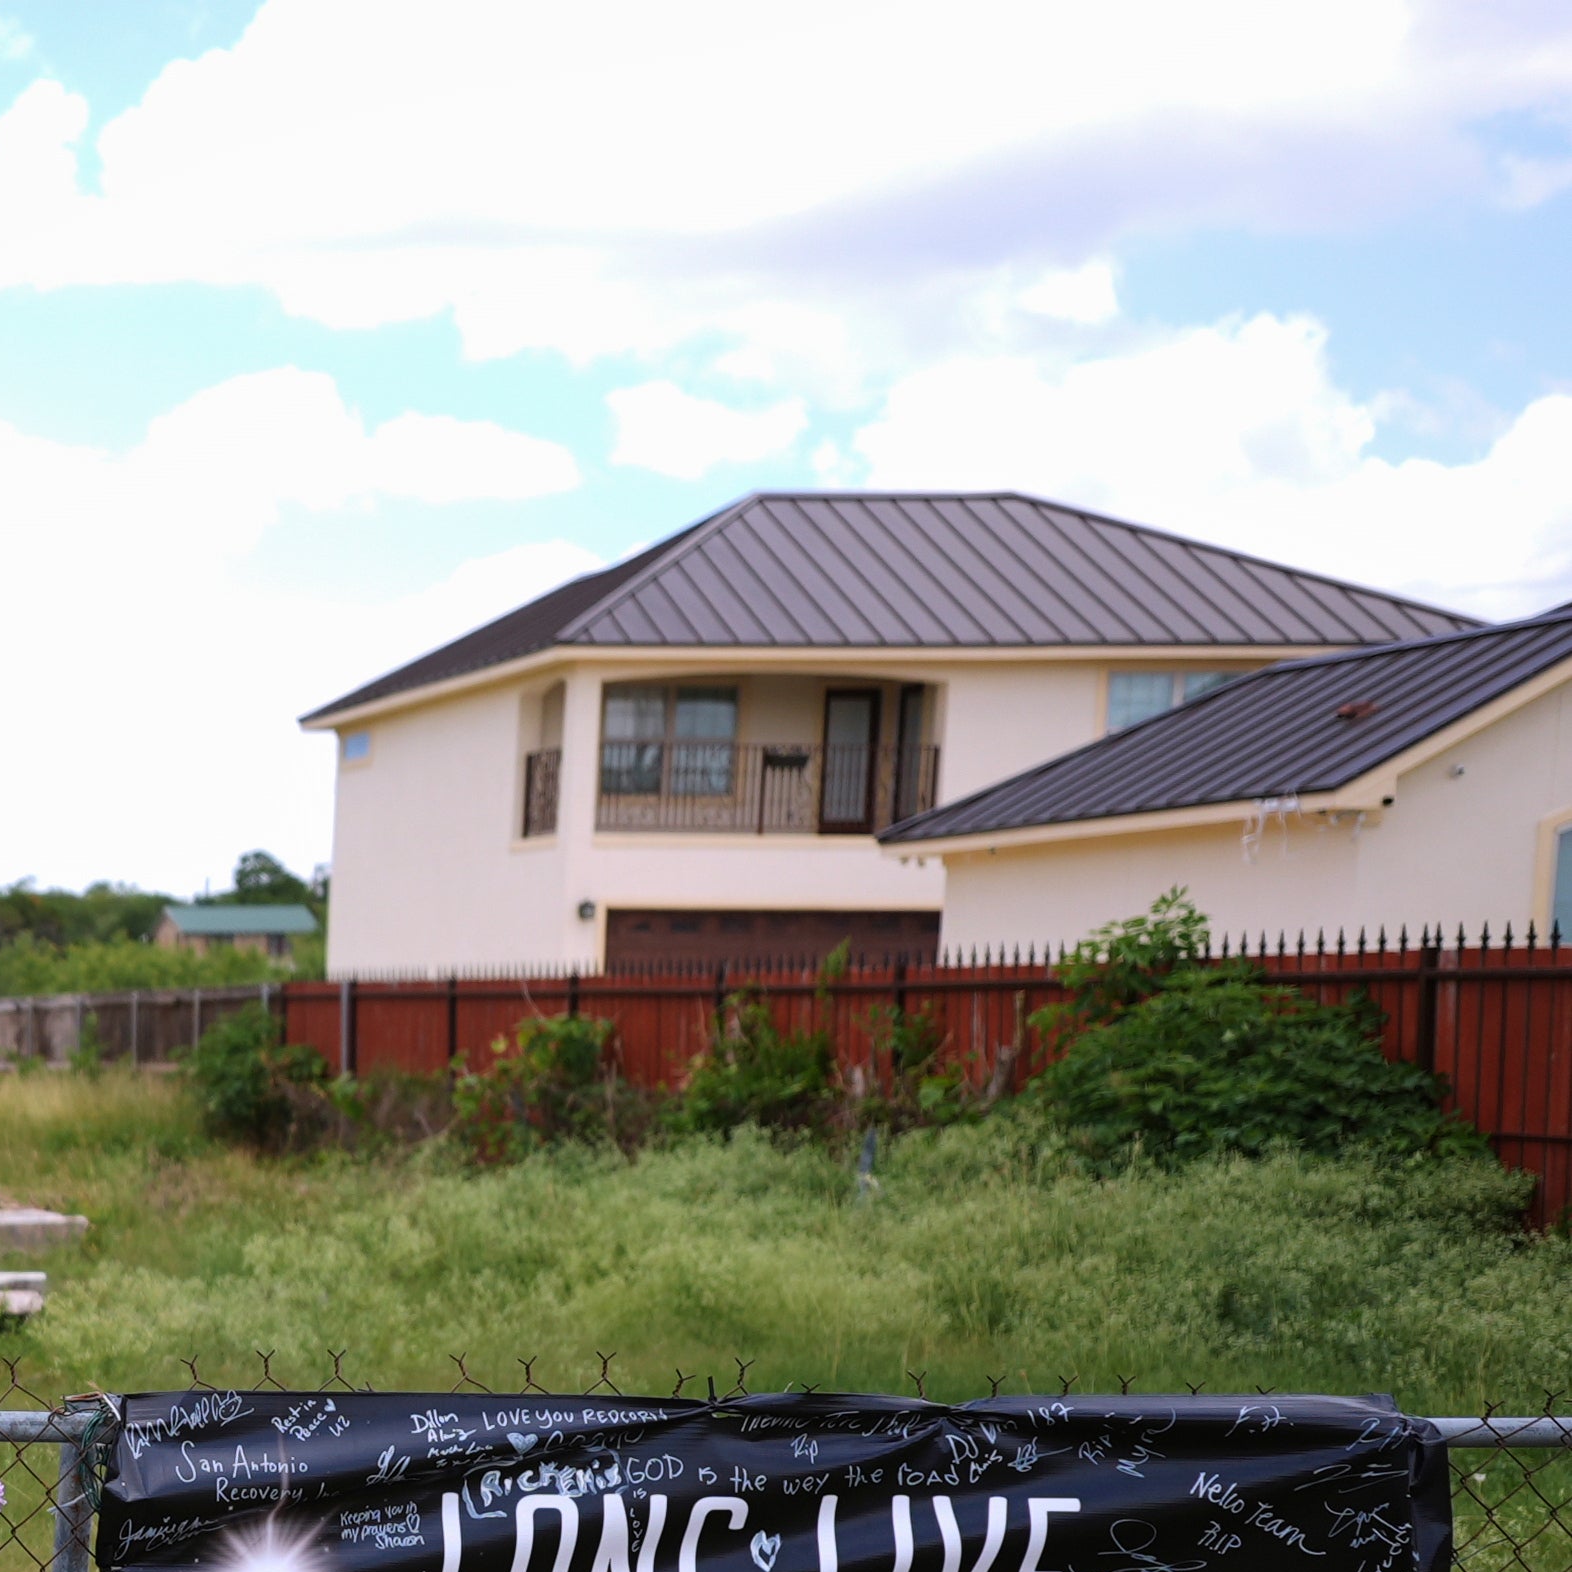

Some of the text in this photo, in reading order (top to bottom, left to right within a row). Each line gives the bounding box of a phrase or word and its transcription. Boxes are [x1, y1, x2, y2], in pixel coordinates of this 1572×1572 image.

[482, 1408, 531, 1430] LOVE
[535, 1409, 574, 1429] YOU
[175, 1440, 308, 1483] San Antonio
[626, 1453, 684, 1485] GOD
[729, 1465, 768, 1494] the
[844, 1465, 884, 1488] the
